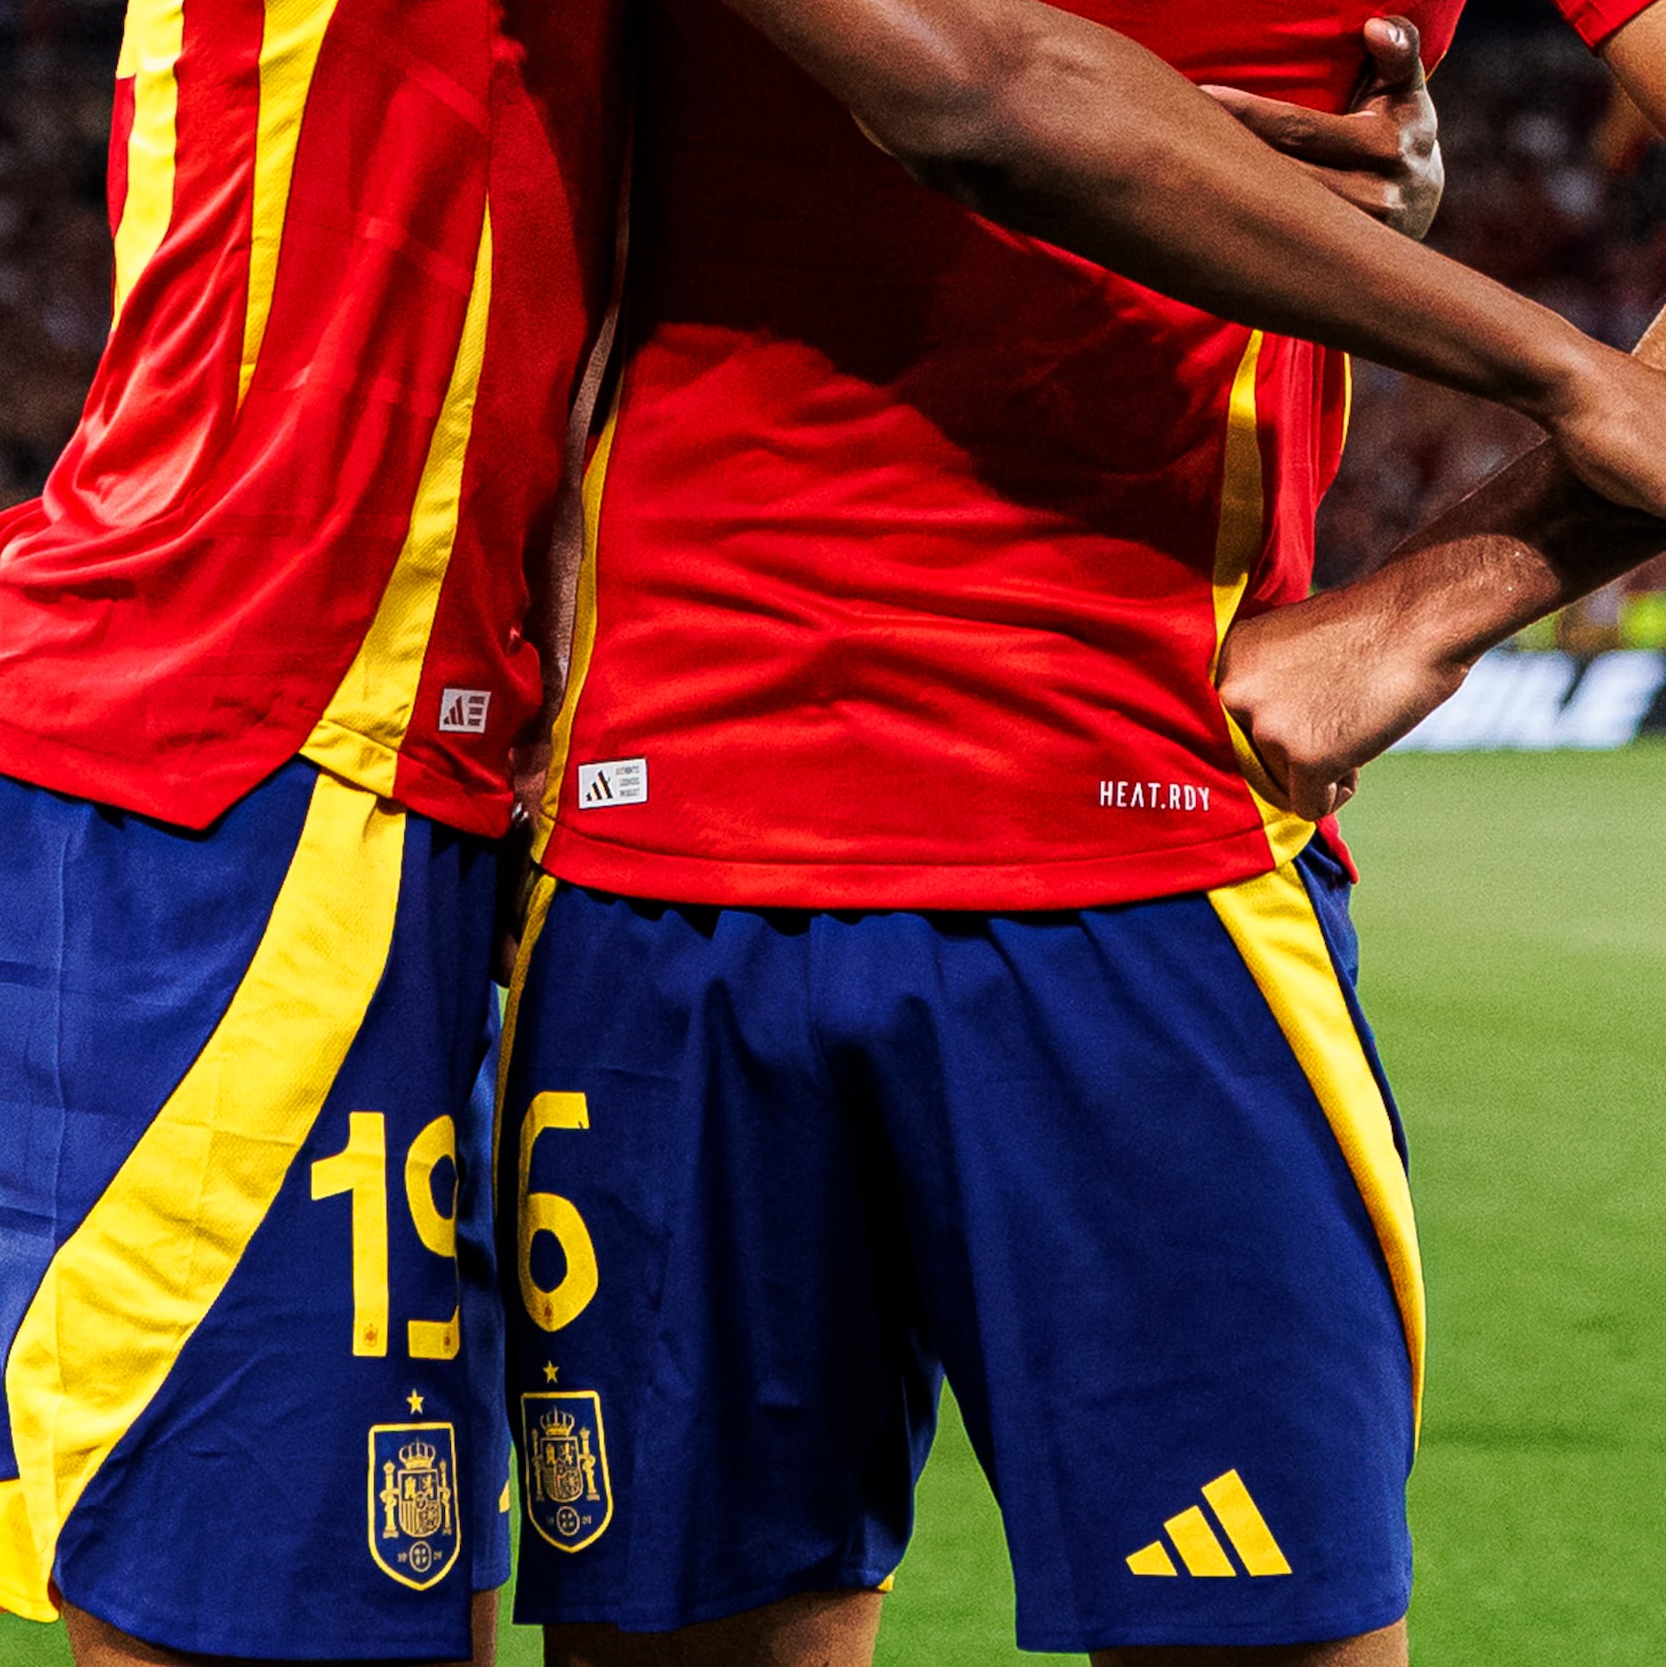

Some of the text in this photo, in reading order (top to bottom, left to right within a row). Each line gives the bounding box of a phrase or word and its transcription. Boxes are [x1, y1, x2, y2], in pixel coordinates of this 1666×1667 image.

[1099, 780, 1210, 811] HEAT.RDY
[311, 1111, 460, 1360] 19
[518, 1091, 598, 1332] 6
